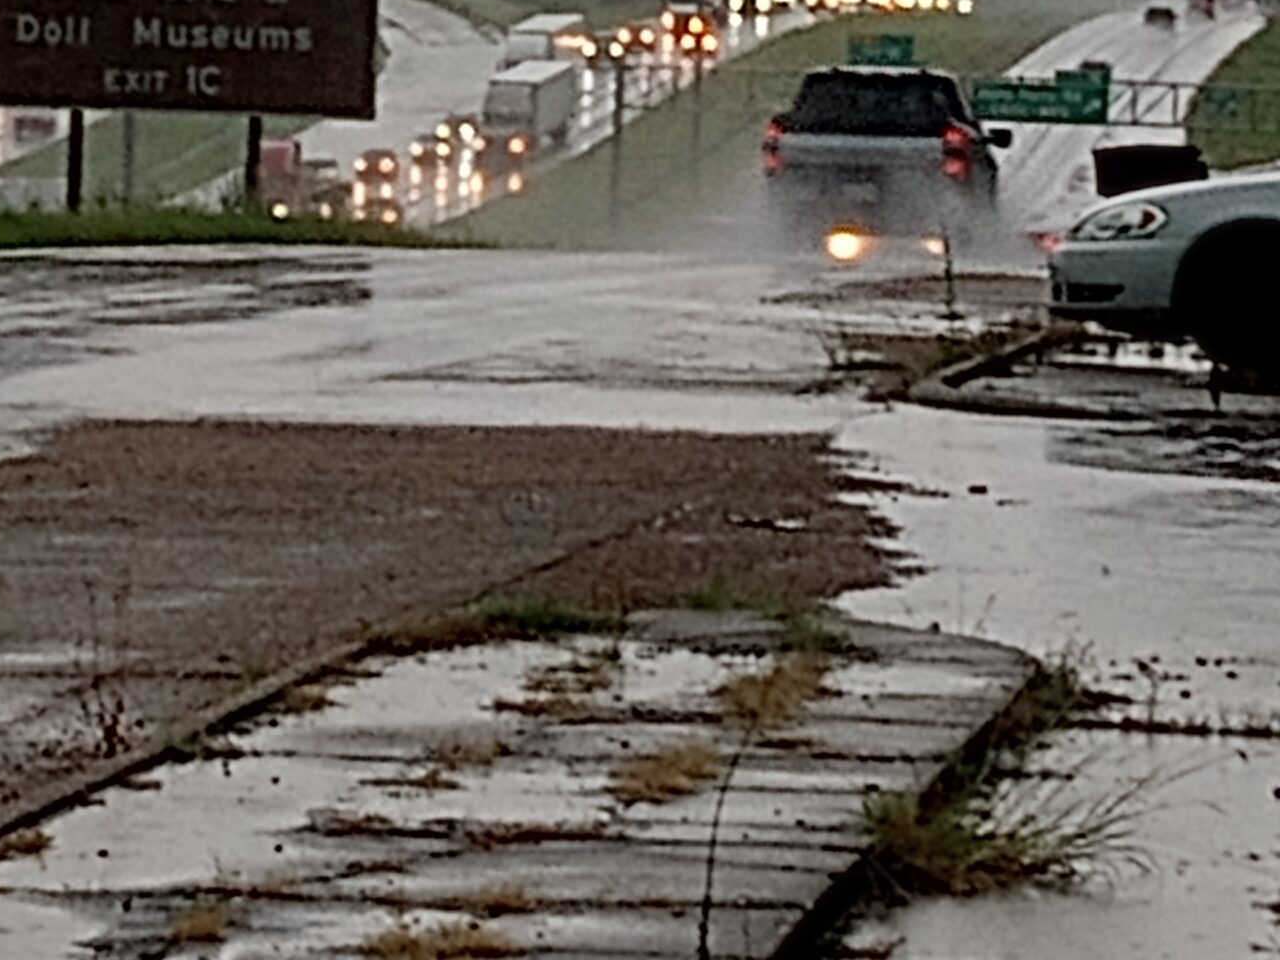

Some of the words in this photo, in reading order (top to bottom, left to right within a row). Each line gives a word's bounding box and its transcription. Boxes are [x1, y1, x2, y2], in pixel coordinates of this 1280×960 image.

[15, 14, 90, 47] Doll
[133, 17, 313, 52] Museums
[103, 69, 169, 93] EXIT
